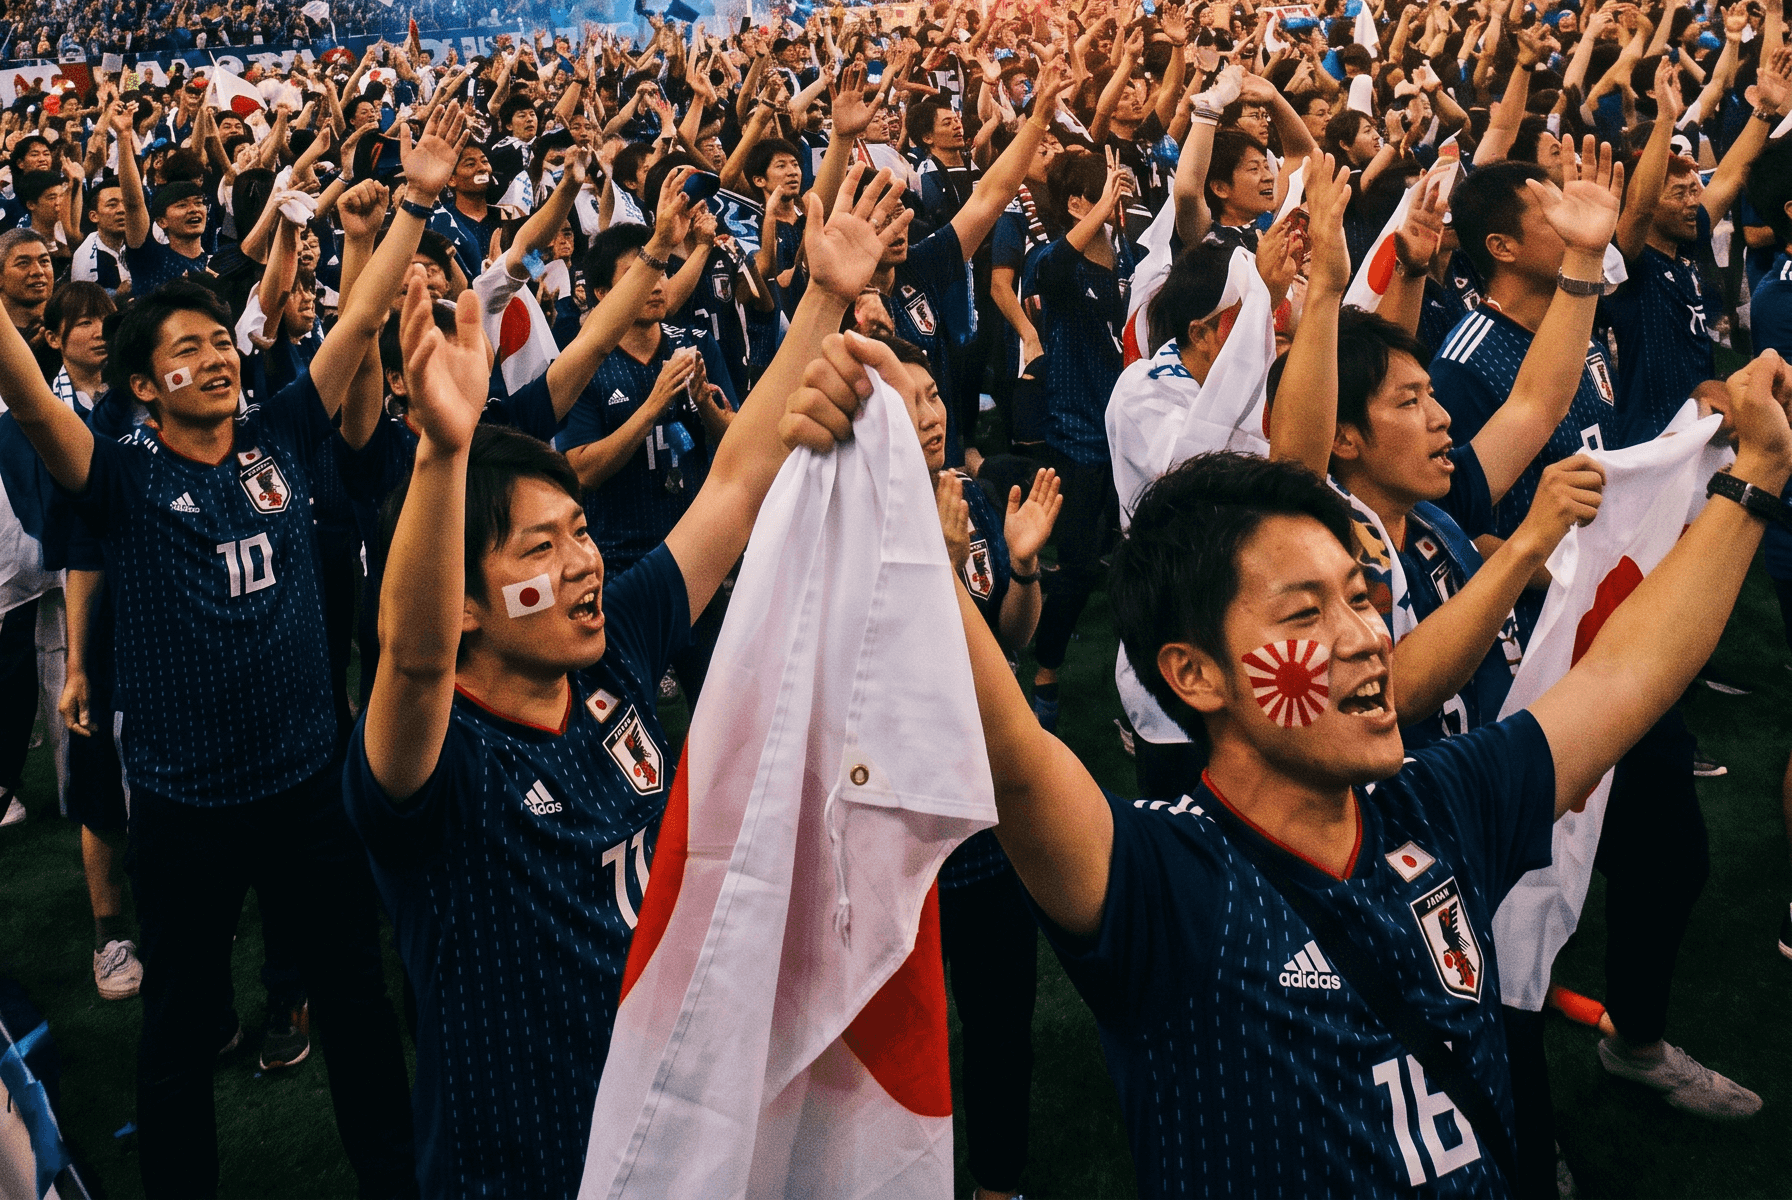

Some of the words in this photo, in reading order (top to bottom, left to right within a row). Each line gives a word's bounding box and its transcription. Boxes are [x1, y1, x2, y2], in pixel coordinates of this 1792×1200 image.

[216, 531, 277, 598] 10
[1278, 969, 1342, 990] adidas
[1372, 1041, 1482, 1187] 16
